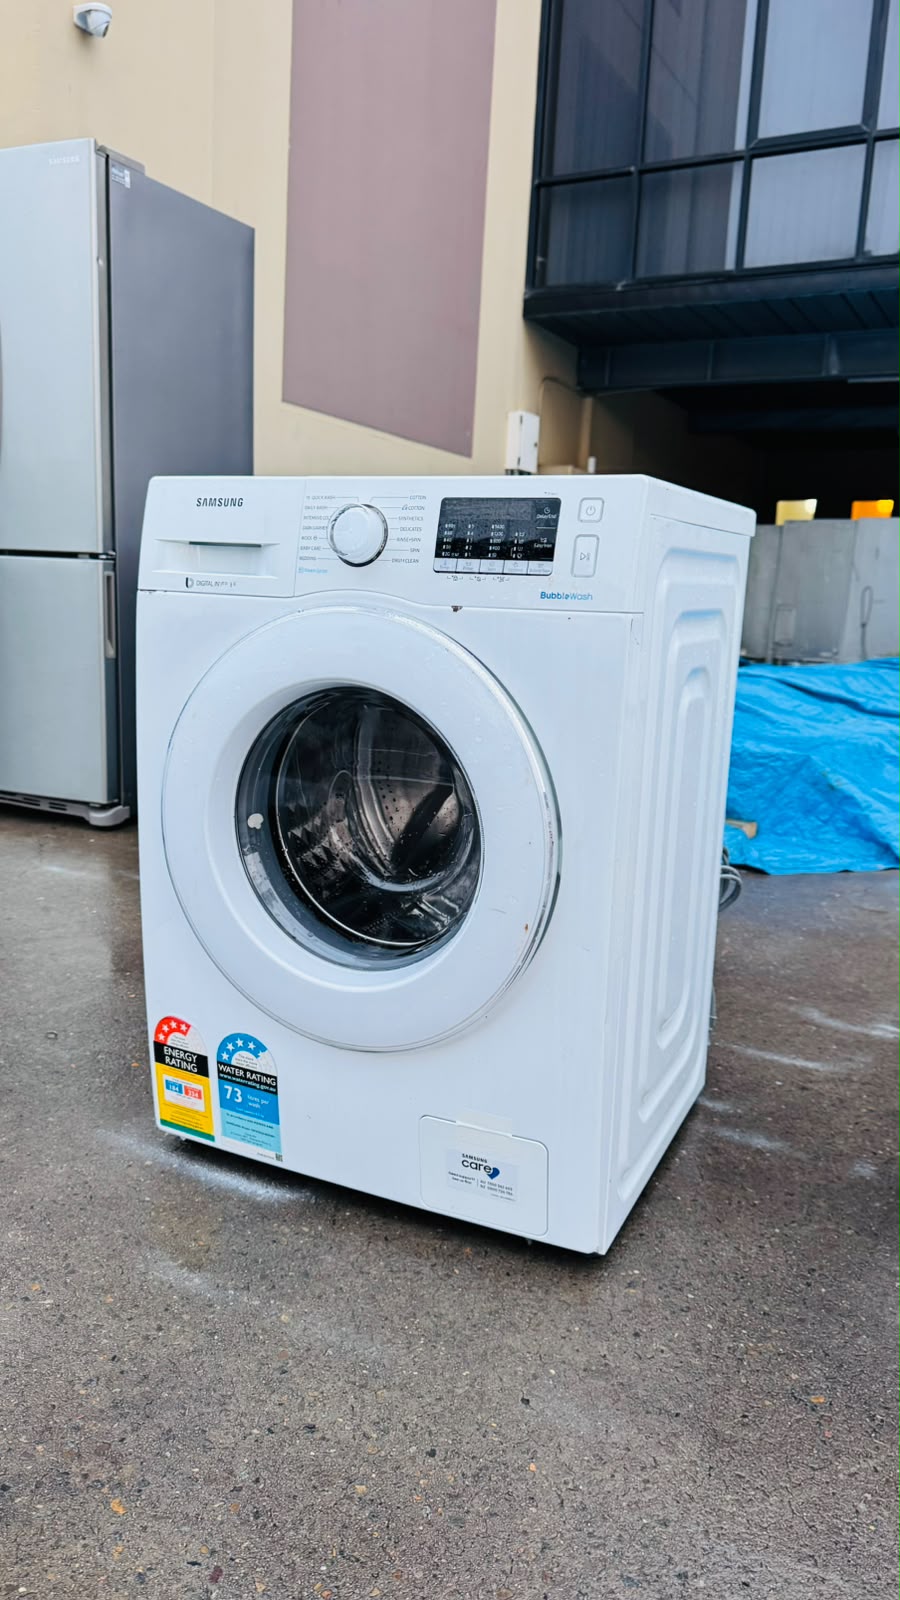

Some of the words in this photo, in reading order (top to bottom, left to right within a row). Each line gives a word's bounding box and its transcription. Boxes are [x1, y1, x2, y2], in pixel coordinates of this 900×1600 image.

[196, 498, 244, 507] SAMSUNG
[164, 1046, 198, 1062] ENERGY
[165, 1056, 198, 1072] RATING
[218, 1064, 244, 1077] WATER
[246, 1071, 276, 1086] RATING
[224, 1085, 242, 1103] 73
[462, 1153, 487, 1163] SAMSUNG
[461, 1160, 492, 1173] care
